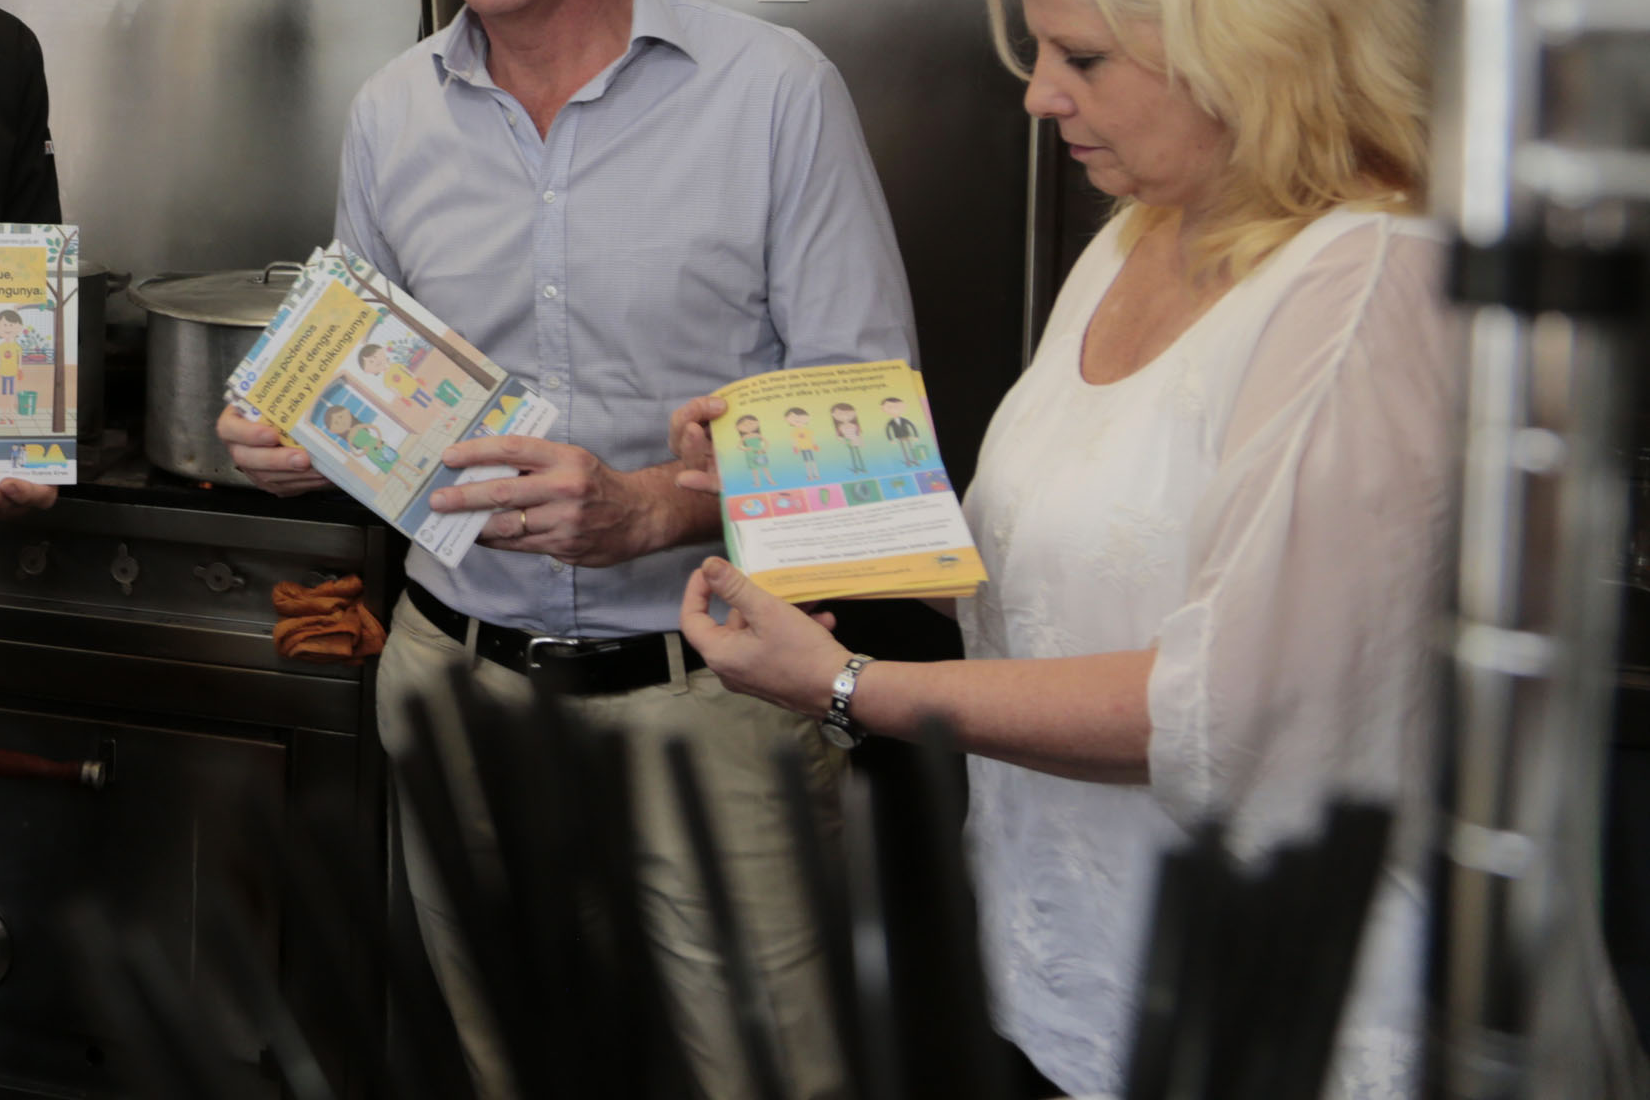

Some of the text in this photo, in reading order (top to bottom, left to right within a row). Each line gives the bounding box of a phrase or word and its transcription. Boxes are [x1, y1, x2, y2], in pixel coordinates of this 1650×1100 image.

[254, 370, 282, 404] Juntos
[279, 324, 318, 373] podemos
[266, 373, 299, 416] prevenir
[287, 391, 306, 413] zika
